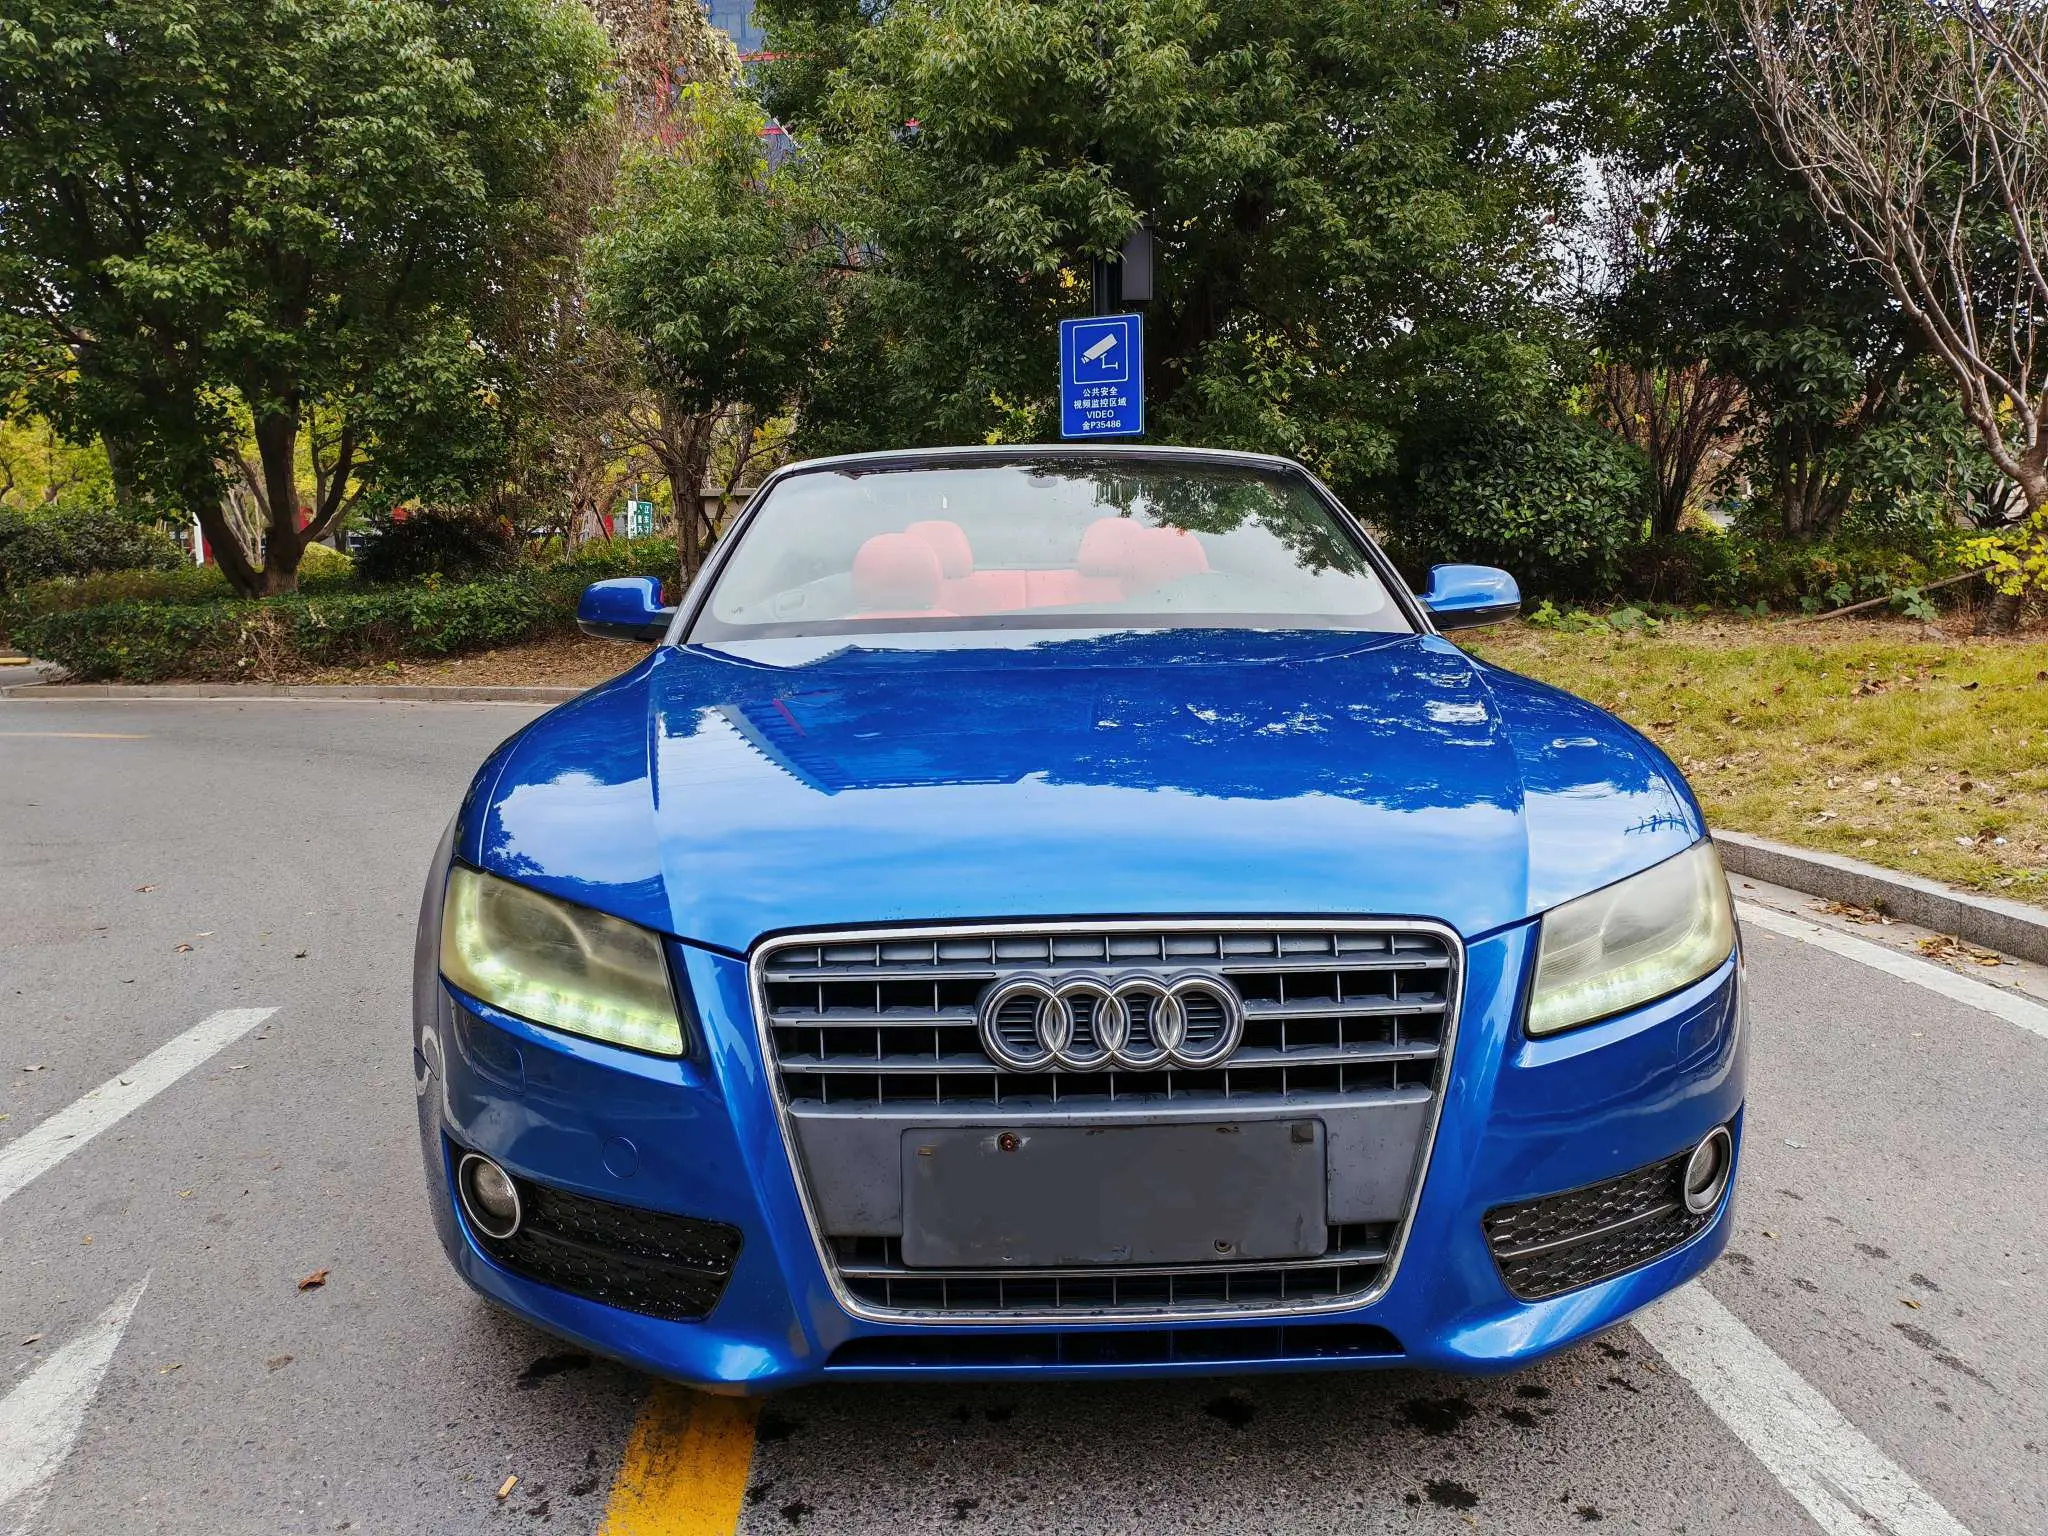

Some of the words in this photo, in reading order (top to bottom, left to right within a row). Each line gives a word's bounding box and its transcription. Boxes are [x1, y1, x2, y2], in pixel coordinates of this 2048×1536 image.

[1083, 386, 1118, 397] 公共安全
[1074, 397, 1127, 410] 视频监控区域
[1086, 410, 1114, 419] VIDEO
